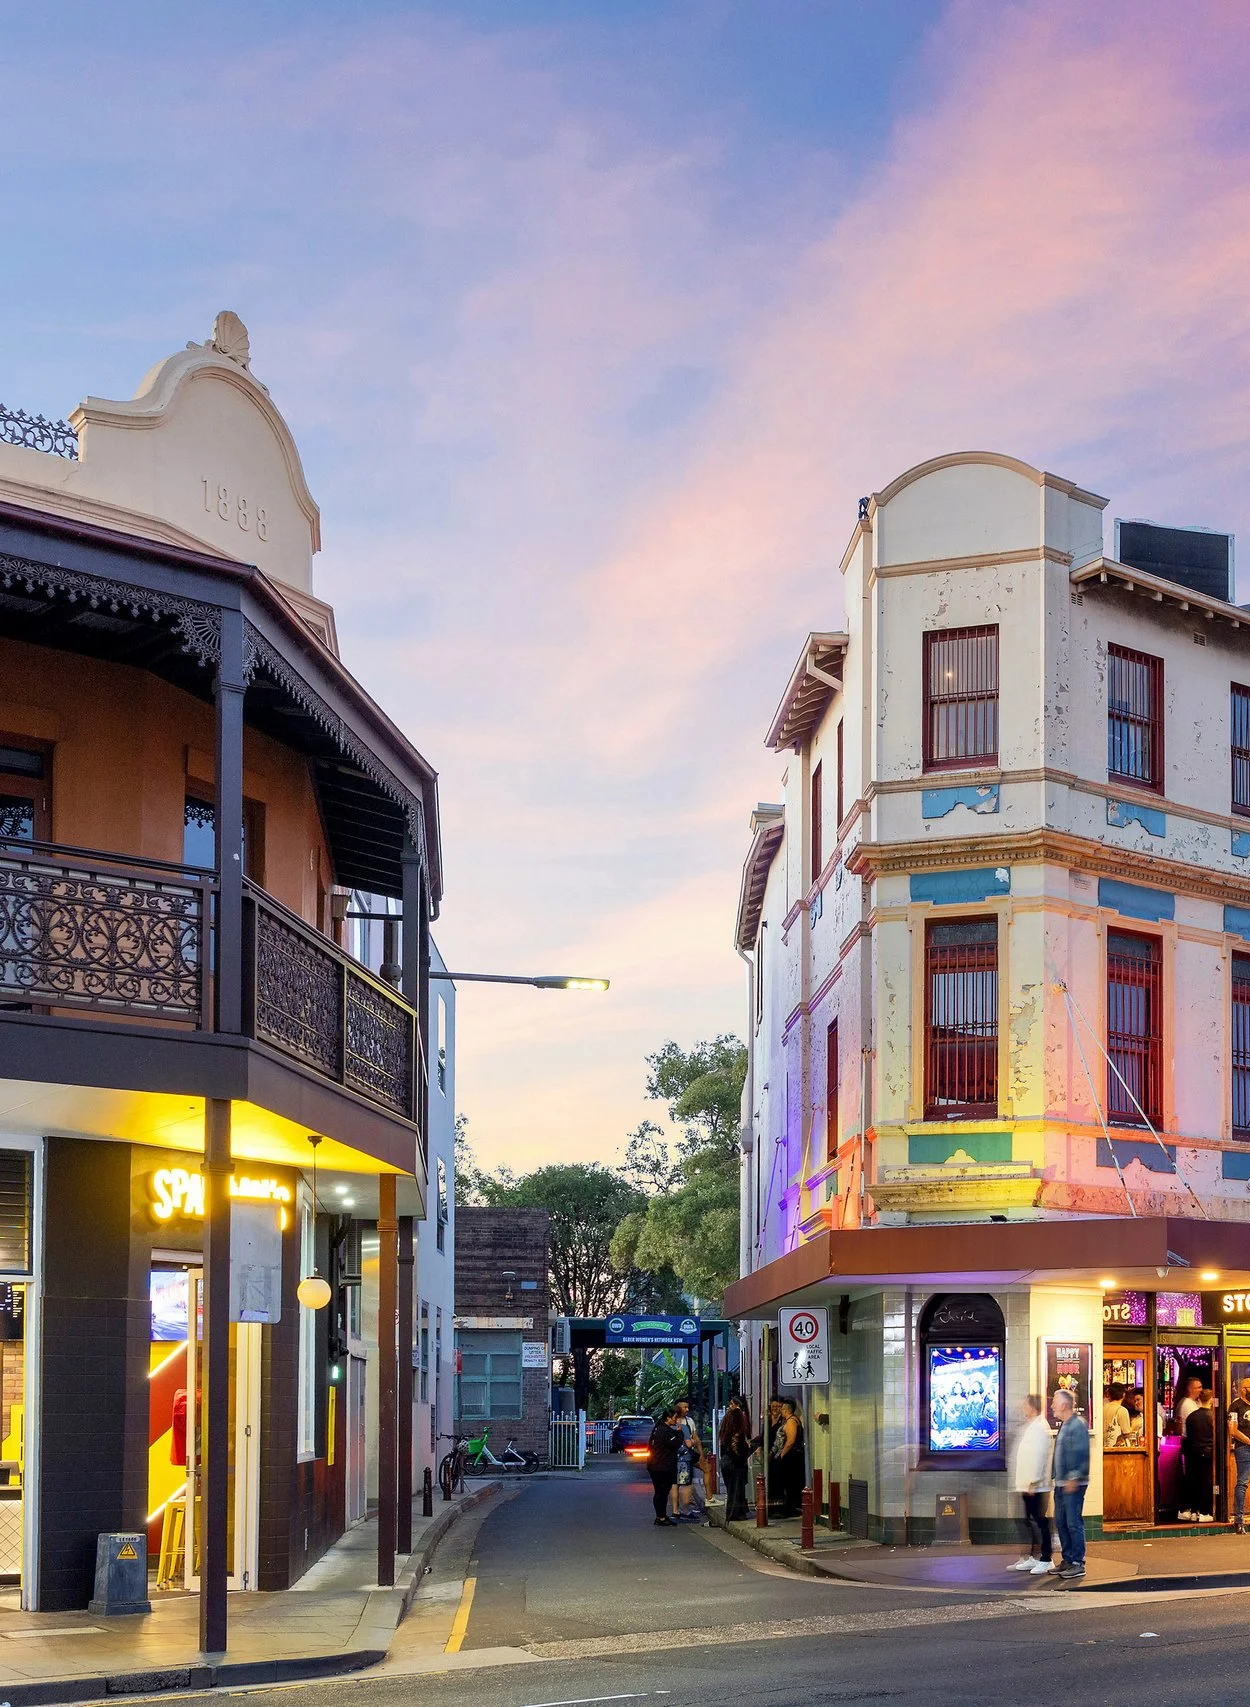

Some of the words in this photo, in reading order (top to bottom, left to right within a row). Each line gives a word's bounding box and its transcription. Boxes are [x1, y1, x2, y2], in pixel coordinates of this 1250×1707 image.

[201, 477, 270, 542] 1888
[794, 1321, 814, 1335] 40
[1055, 1347, 1080, 1359] HAPPY
